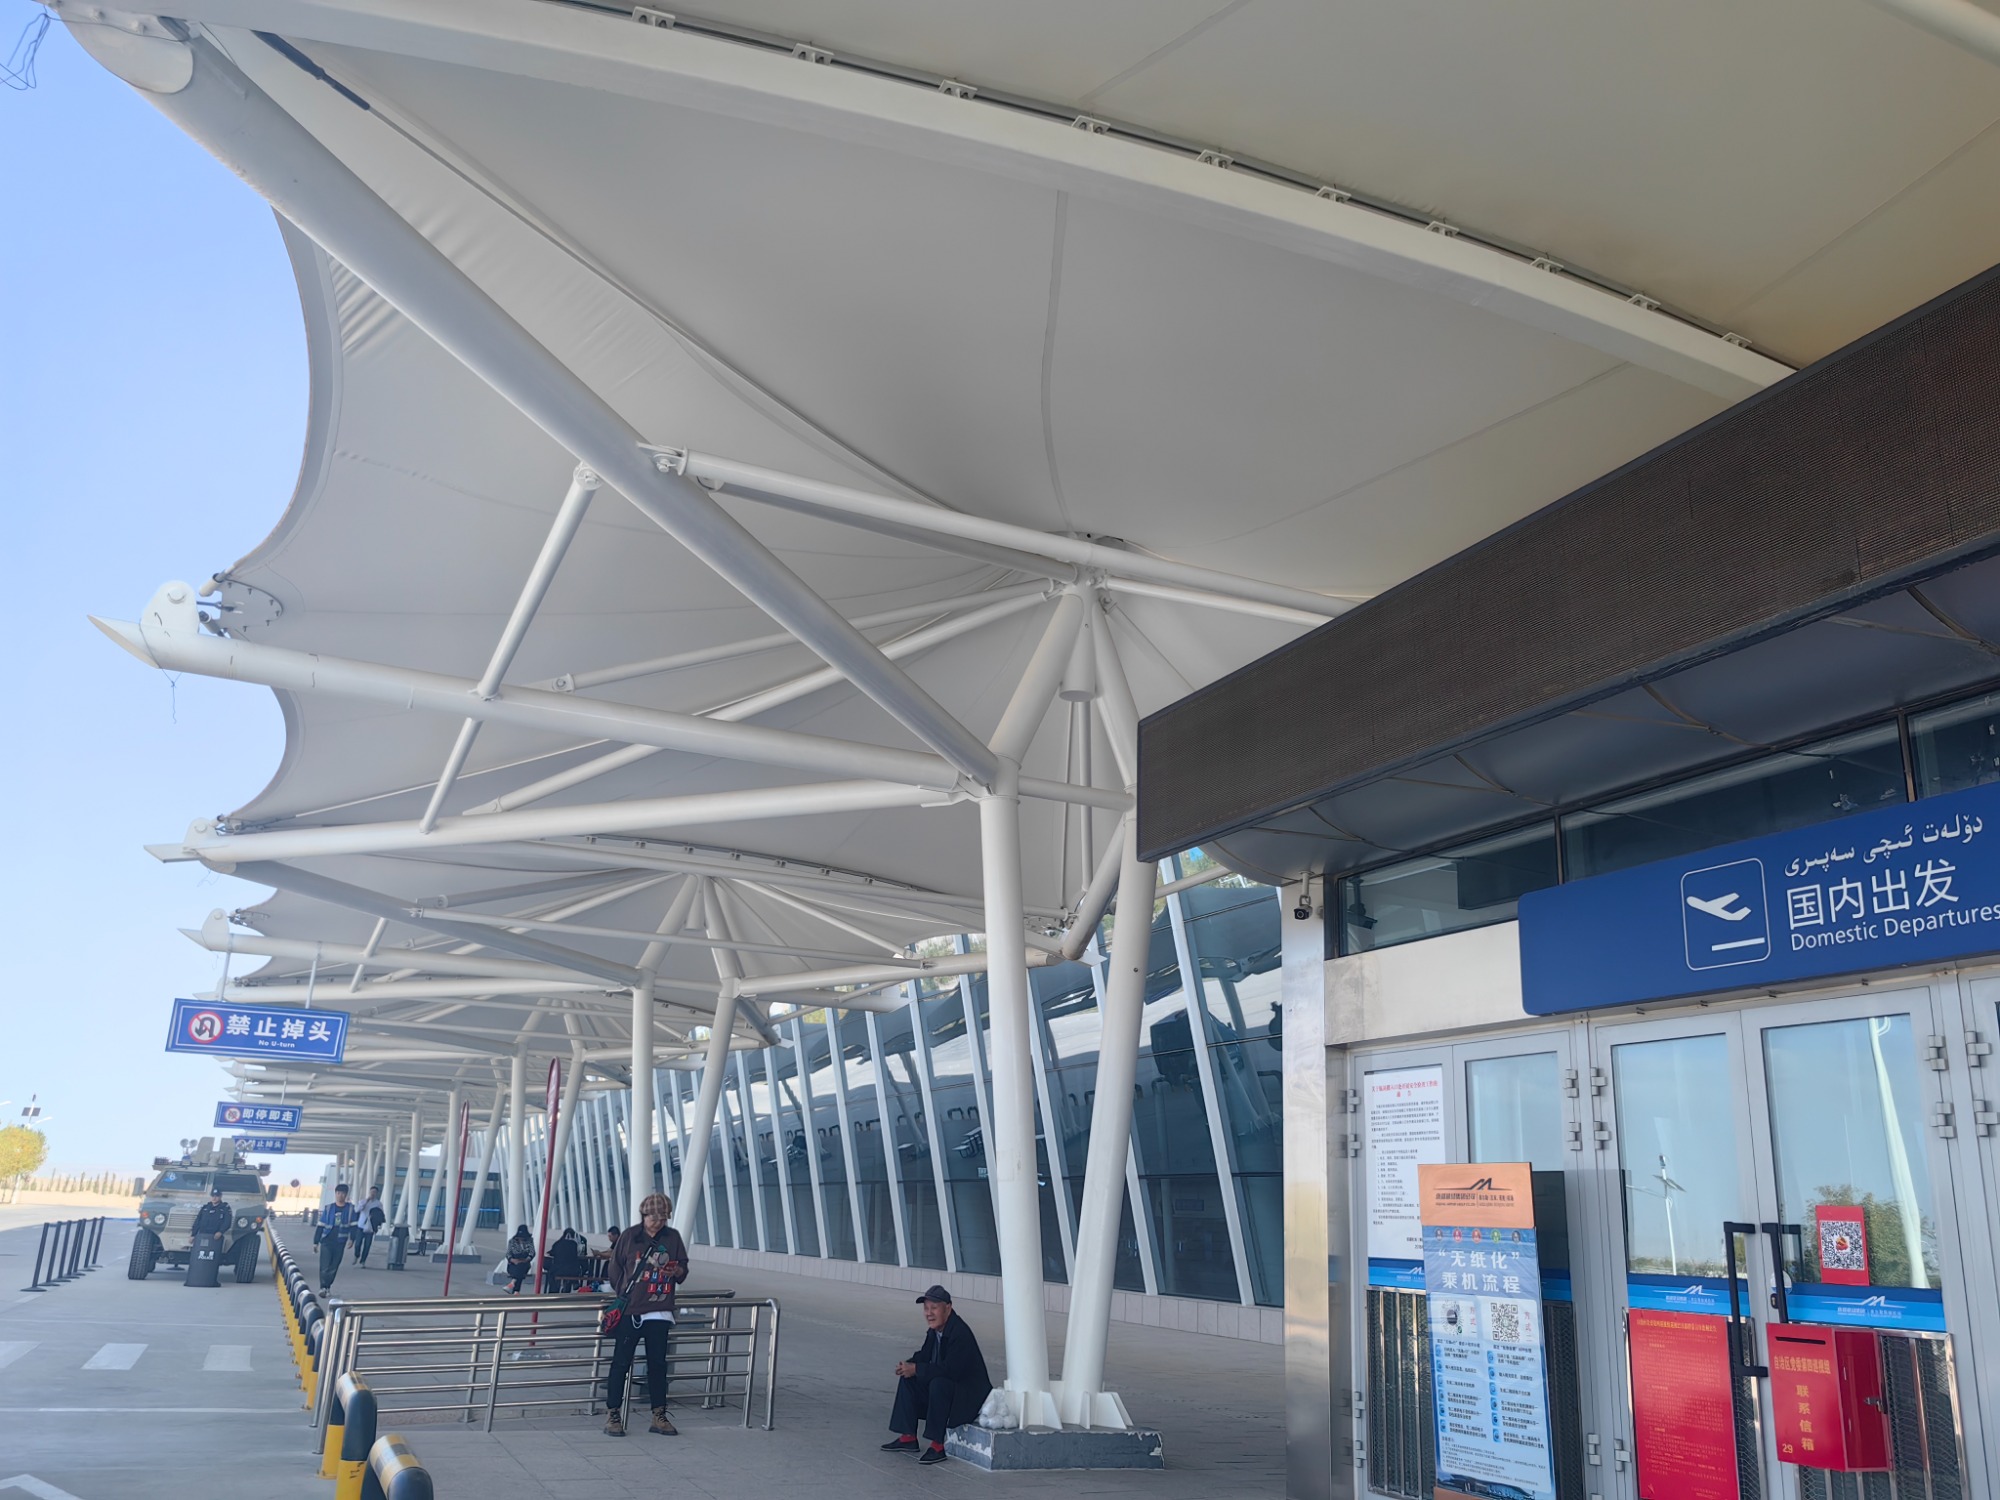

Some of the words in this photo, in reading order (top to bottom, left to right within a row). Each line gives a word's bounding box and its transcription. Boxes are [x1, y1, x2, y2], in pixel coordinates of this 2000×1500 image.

[1786, 858, 1959, 930] 国内出发
[1790, 921, 1879, 951] Domestic
[1884, 903, 2000, 938] Departures
[226, 1014, 331, 1042] 禁止掉头
[242, 1108, 293, 1122] 即停即走
[1438, 1248, 1520, 1270] “无纸化”
[1442, 1272, 1521, 1293] 乘机流程
[1796, 1384, 1815, 1451] 联系信箱
[1782, 1443, 1793, 1453] 29
